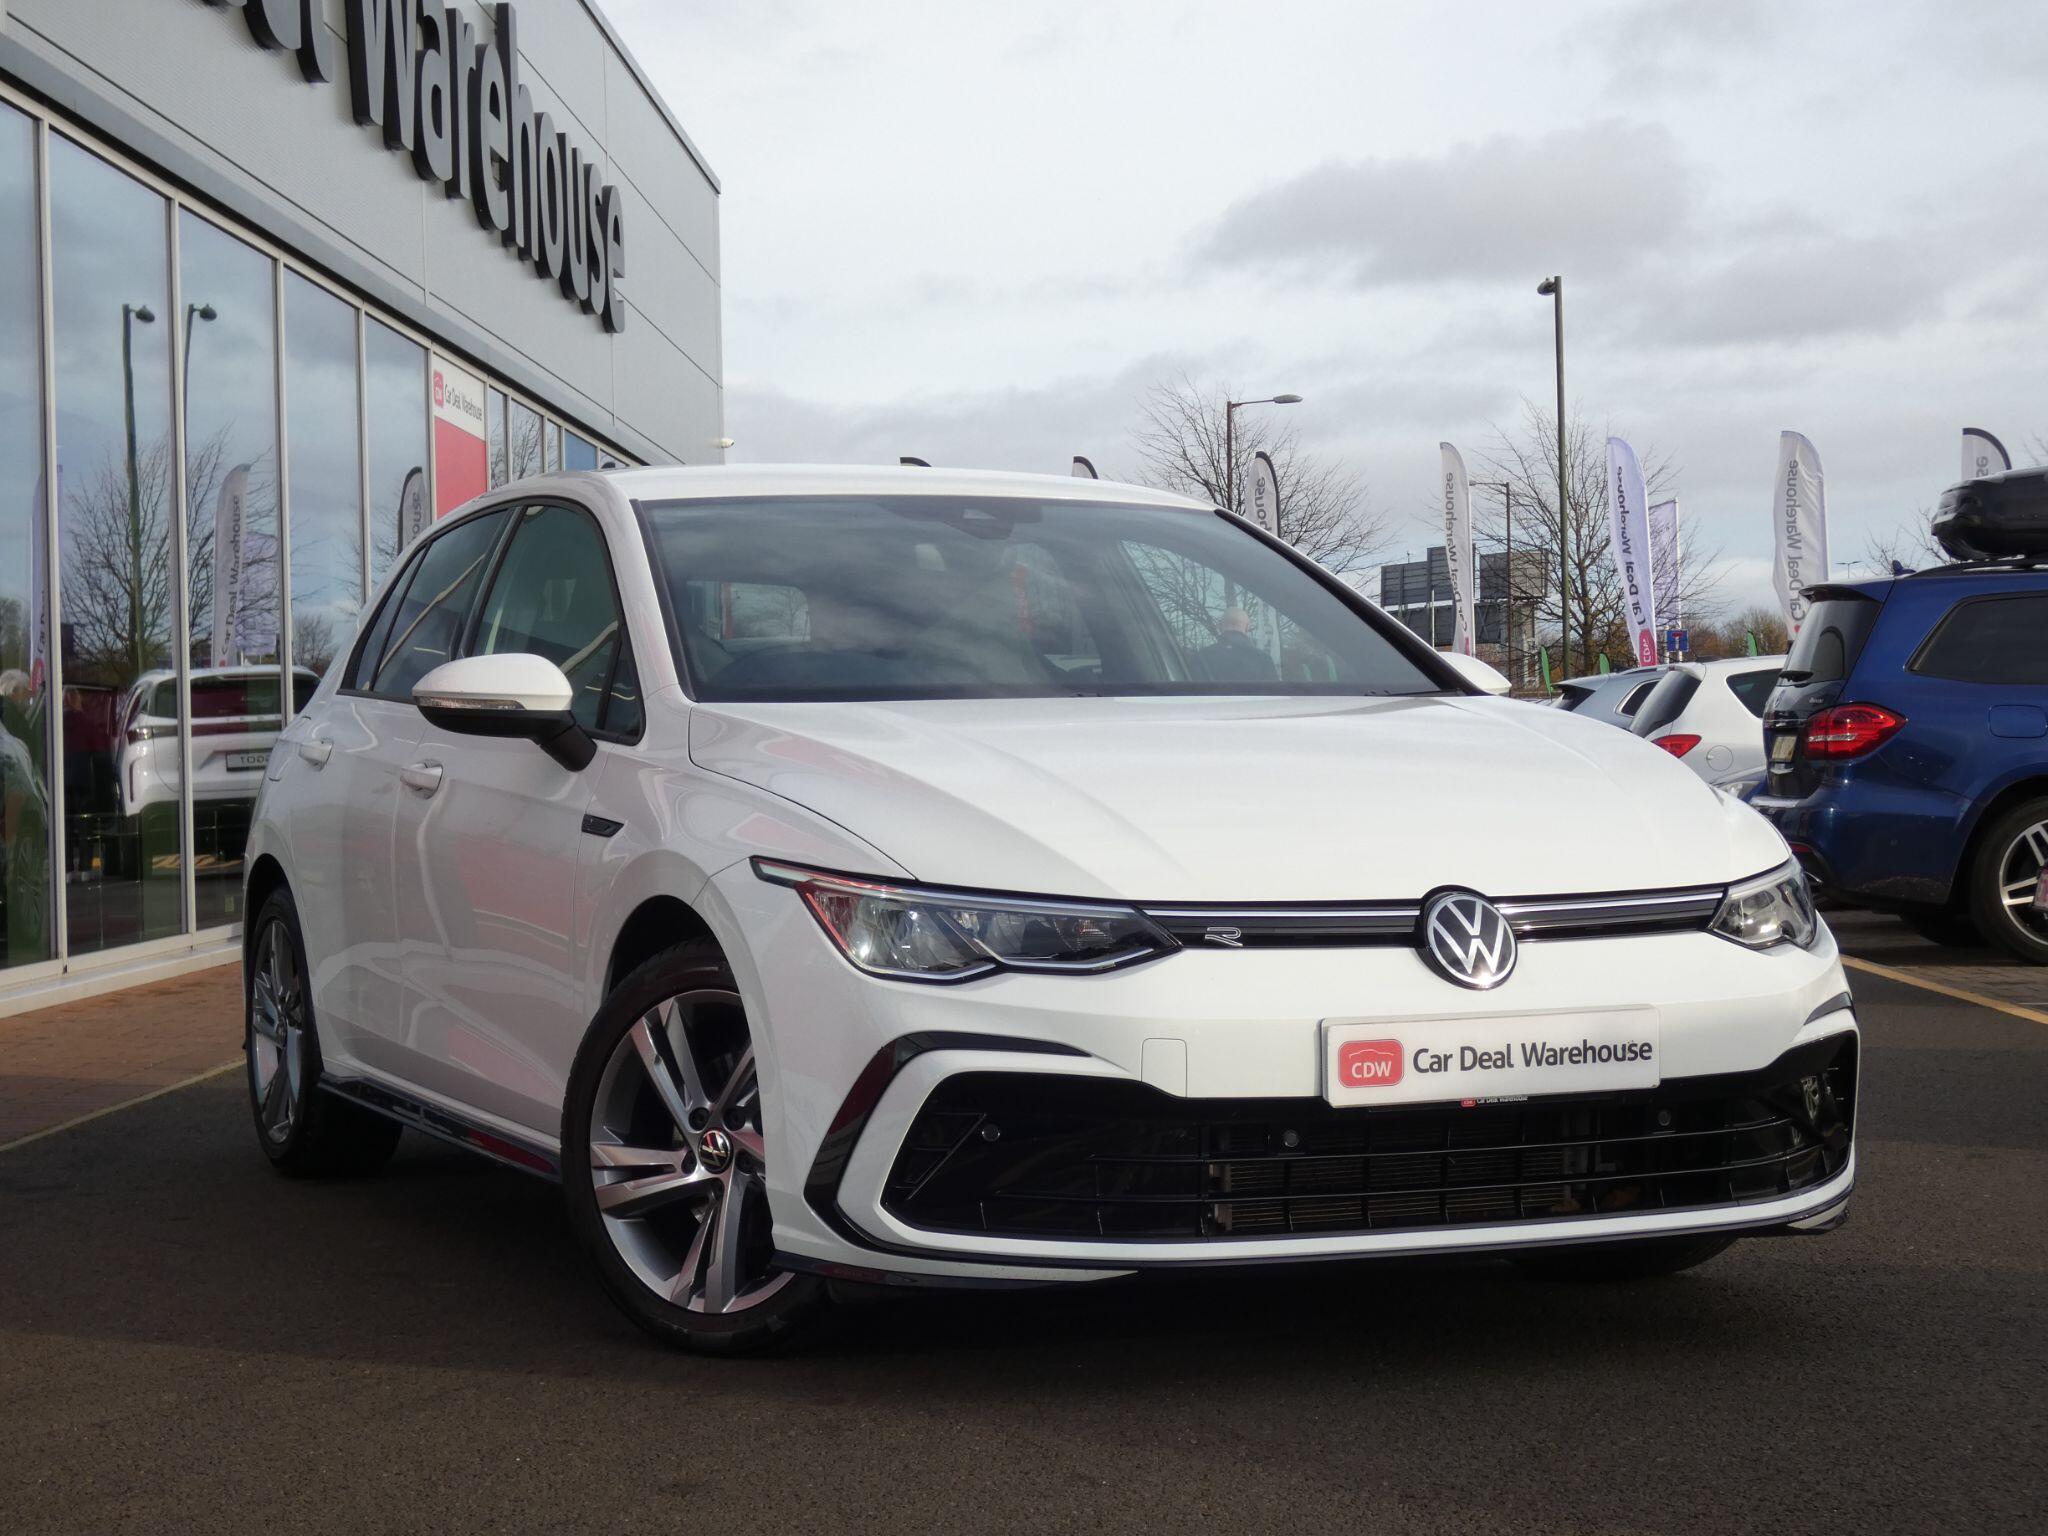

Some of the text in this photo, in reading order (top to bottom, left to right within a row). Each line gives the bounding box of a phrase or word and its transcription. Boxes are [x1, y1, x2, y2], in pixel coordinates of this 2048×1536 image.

[345, 0, 626, 334] Warehouse
[1351, 1060, 1392, 1079] CDW
[1413, 1038, 1653, 1074] Car Deal Warehouse
